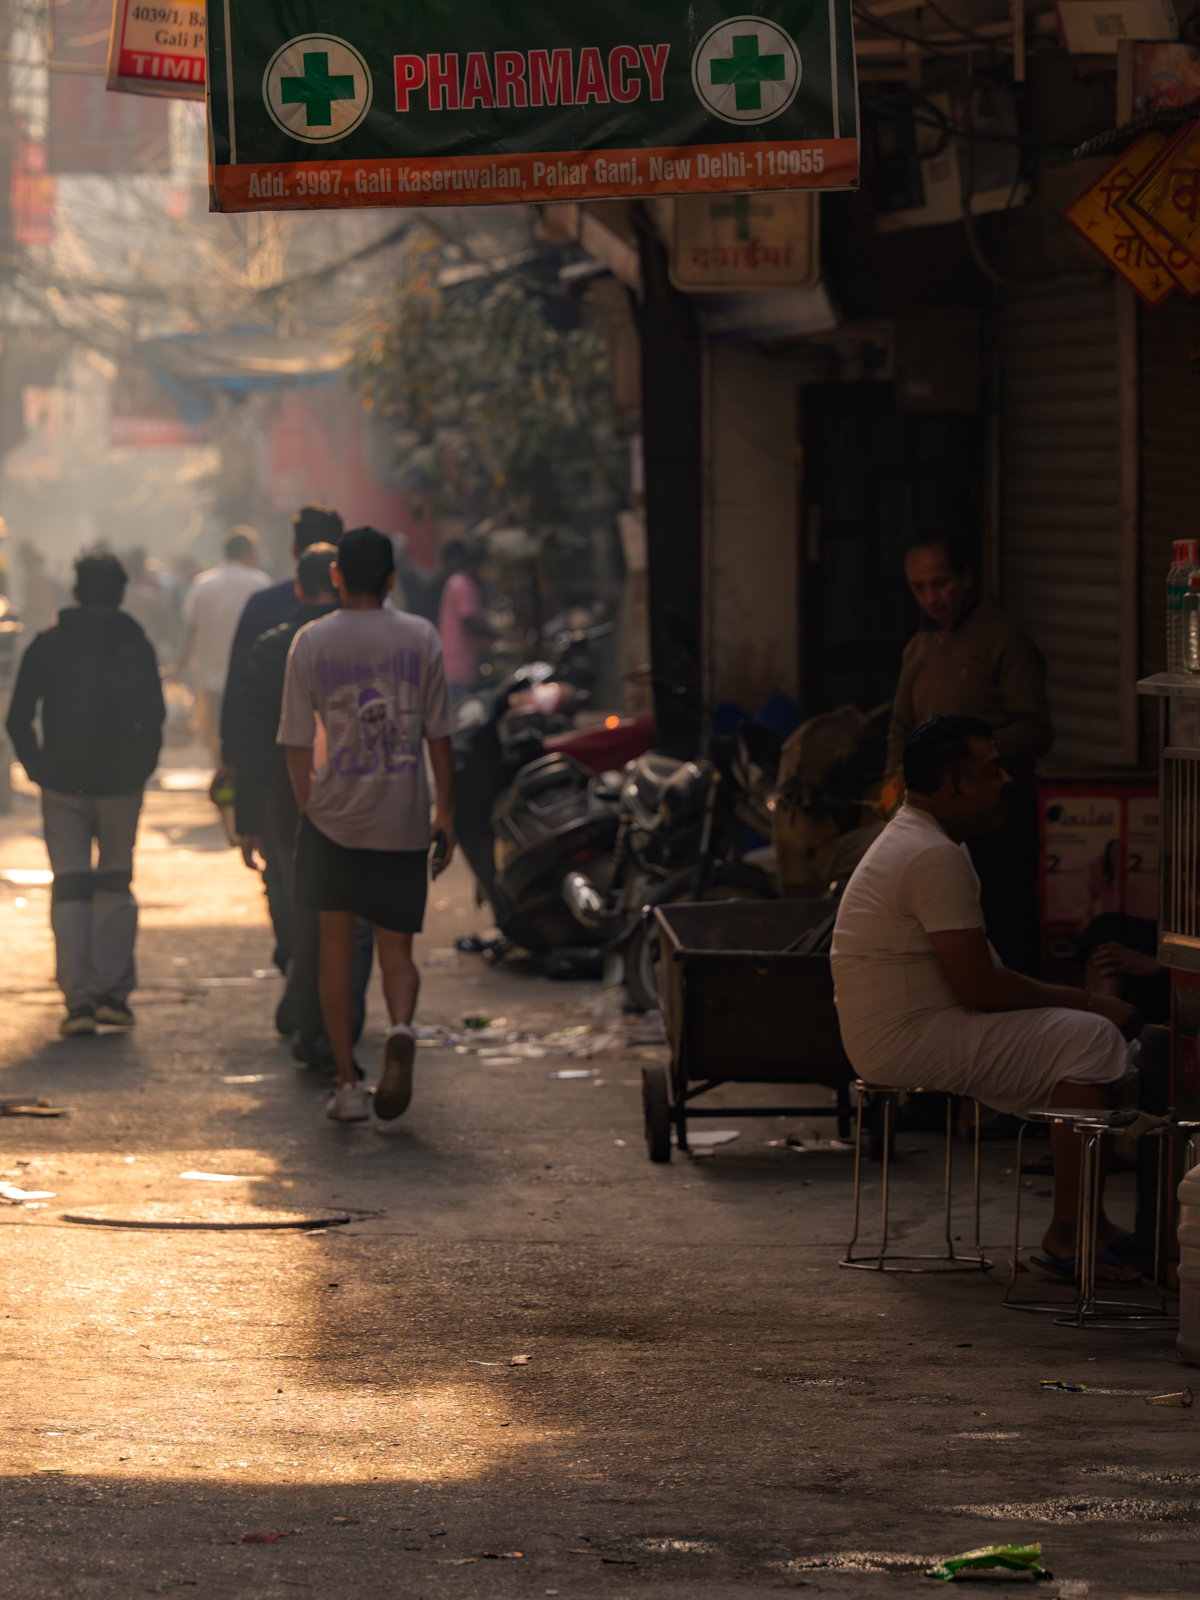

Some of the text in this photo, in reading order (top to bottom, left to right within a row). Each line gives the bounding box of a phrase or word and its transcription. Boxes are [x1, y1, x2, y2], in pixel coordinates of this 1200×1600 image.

[132, 6, 183, 27] 4039/1,
[155, 30, 205, 49] Gali P
[131, 53, 202, 81] TIMI
[393, 44, 671, 112] PHARMACY
[248, 148, 824, 198] Add. 3987, Gali Kaseruwalan, Pahar Ganj, New Delhi-110055
